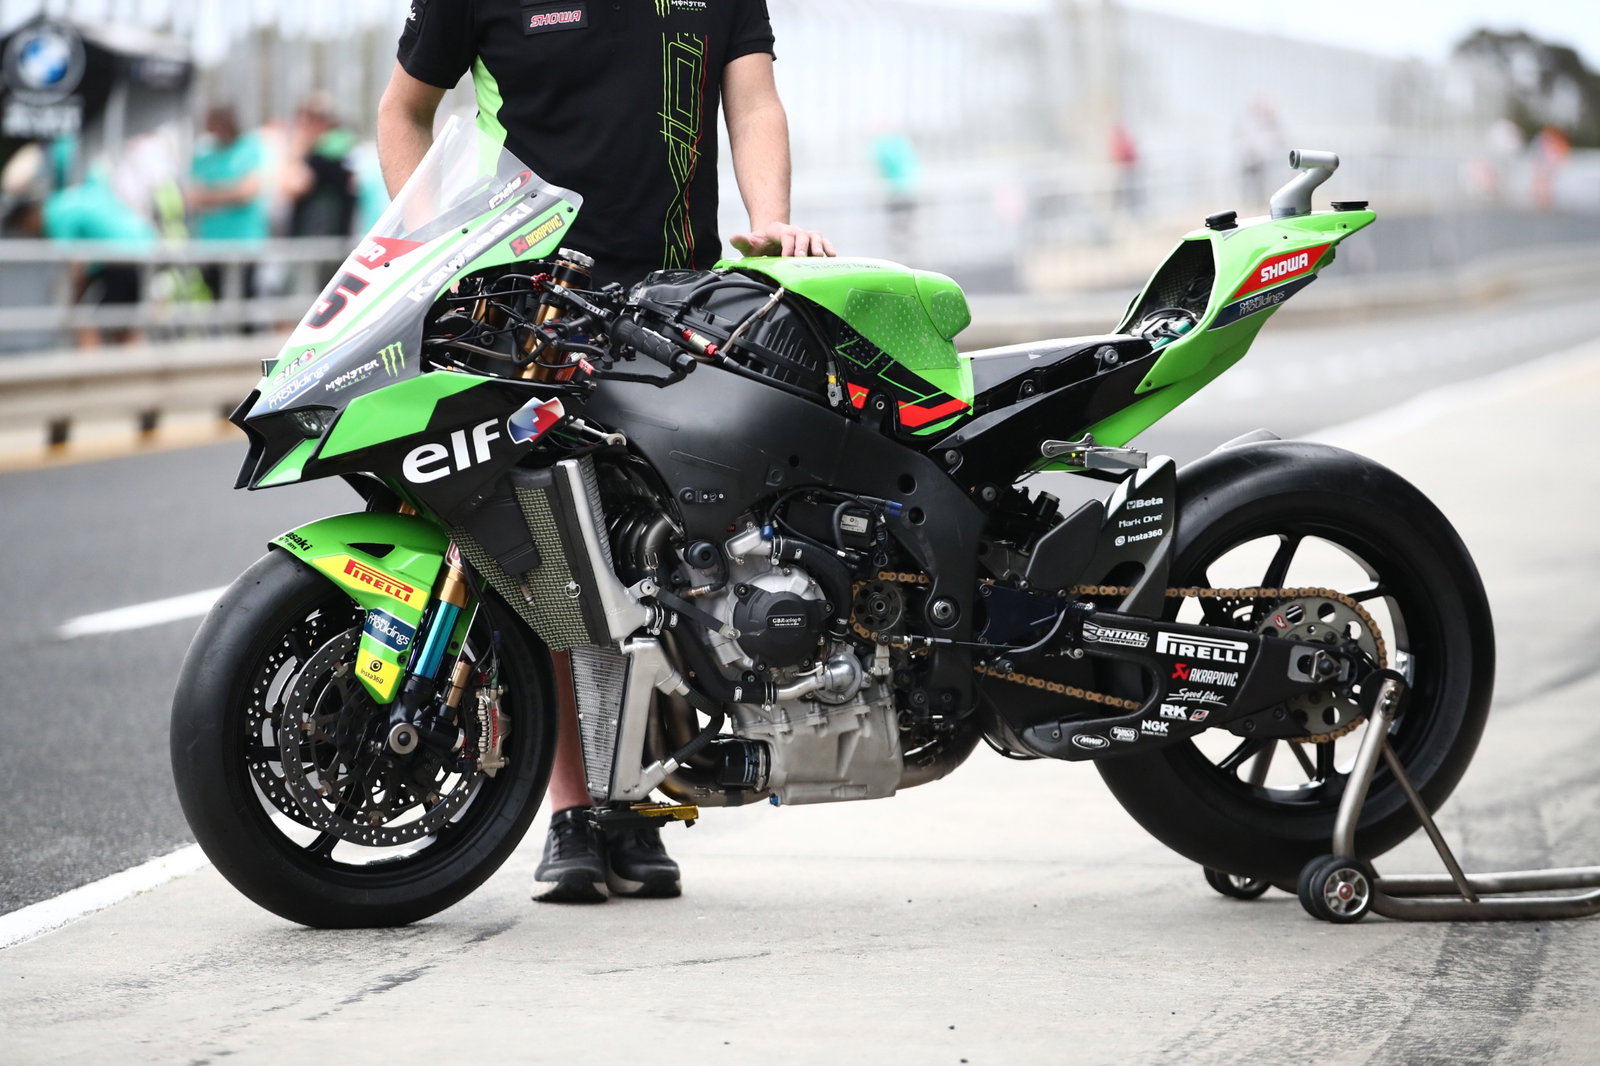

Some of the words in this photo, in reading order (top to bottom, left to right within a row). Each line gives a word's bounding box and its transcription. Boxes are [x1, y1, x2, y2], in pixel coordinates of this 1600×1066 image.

[530, 10, 581, 28] SHOWA
[1260, 252, 1308, 283] SHOWA
[325, 359, 379, 391] MONSTER
[402, 418, 500, 484] elf
[1136, 497, 1164, 508] Beta
[1118, 518, 1141, 528] Mark
[1127, 528, 1163, 543] Insta360
[343, 558, 414, 602] PIRELLI
[367, 614, 410, 645] mouldings
[1156, 631, 1249, 664] PIRELLI
[1160, 704, 1188, 719] RK
[1141, 720, 1170, 733] NGK
